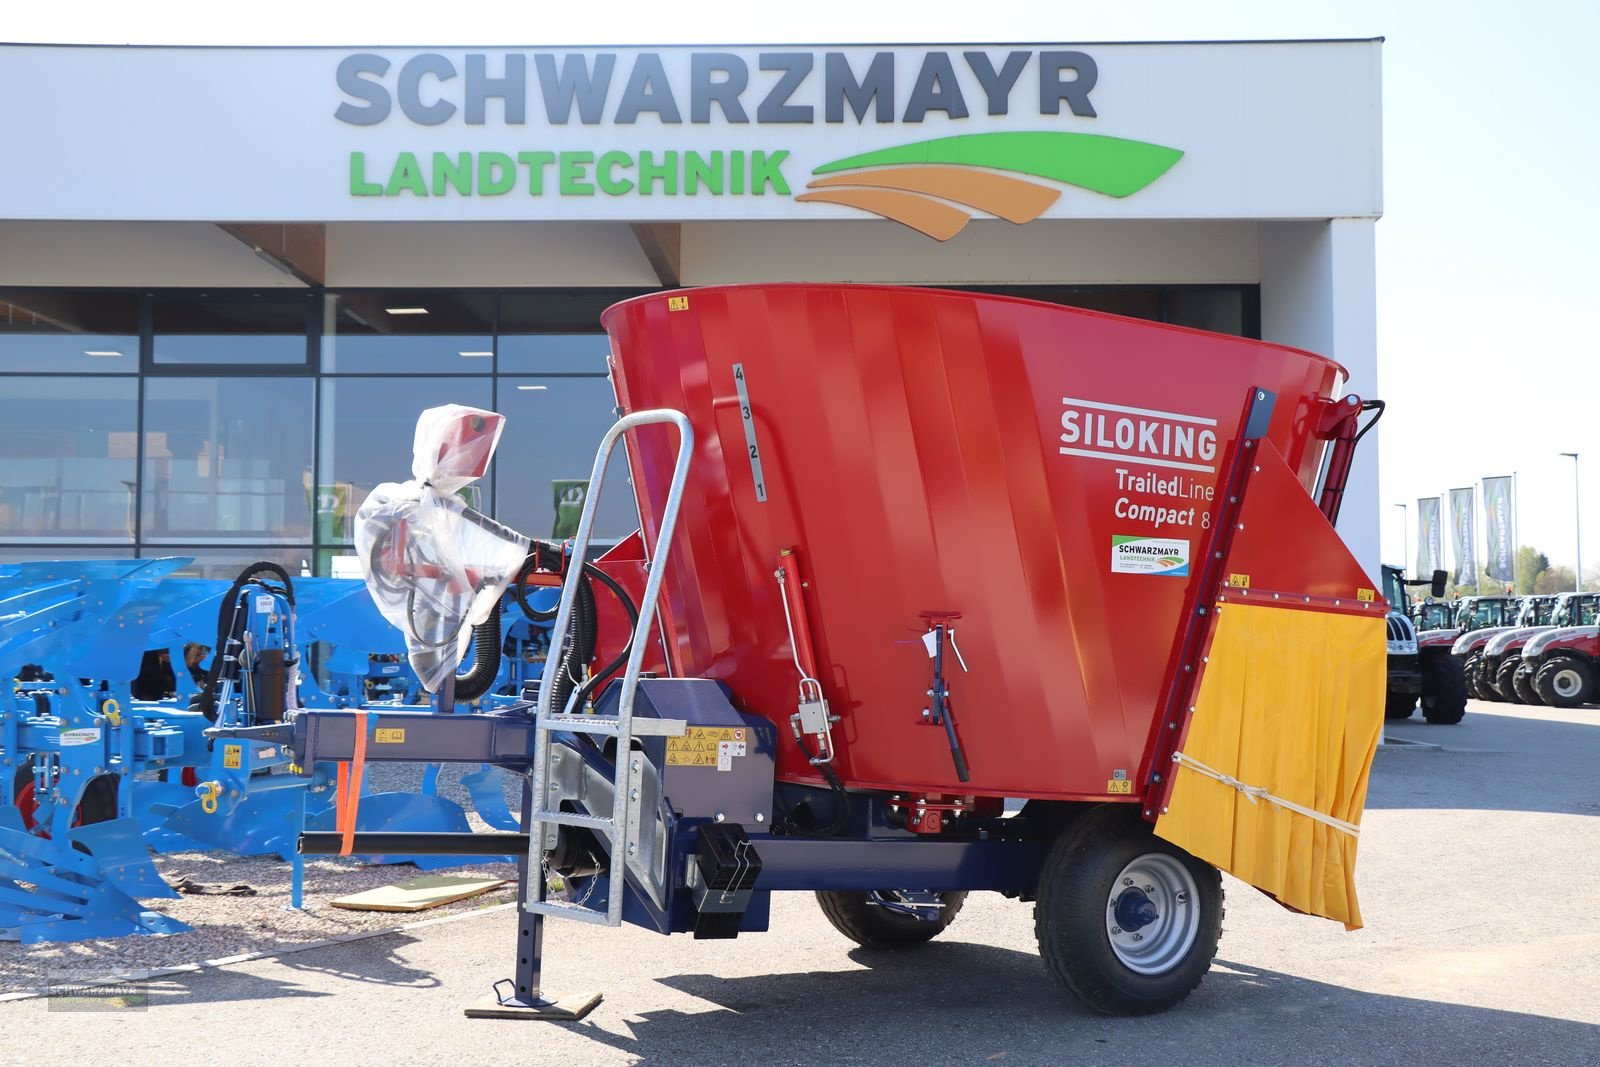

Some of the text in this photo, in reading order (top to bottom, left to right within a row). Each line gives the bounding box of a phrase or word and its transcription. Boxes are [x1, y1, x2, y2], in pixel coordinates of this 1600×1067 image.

[333, 51, 1099, 126] SCHWARZMAYR
[350, 150, 792, 196] LANDTECHNIK
[735, 367, 744, 381] 4
[742, 406, 751, 420] 3
[1060, 410, 1217, 461] SILOKING
[749, 444, 758, 459] 2
[757, 483, 764, 497] 1
[1115, 468, 1215, 501] TrailedLine
[1114, 497, 1211, 530] Compact 8
[1118, 544, 1180, 557] SCHWARZMAYR
